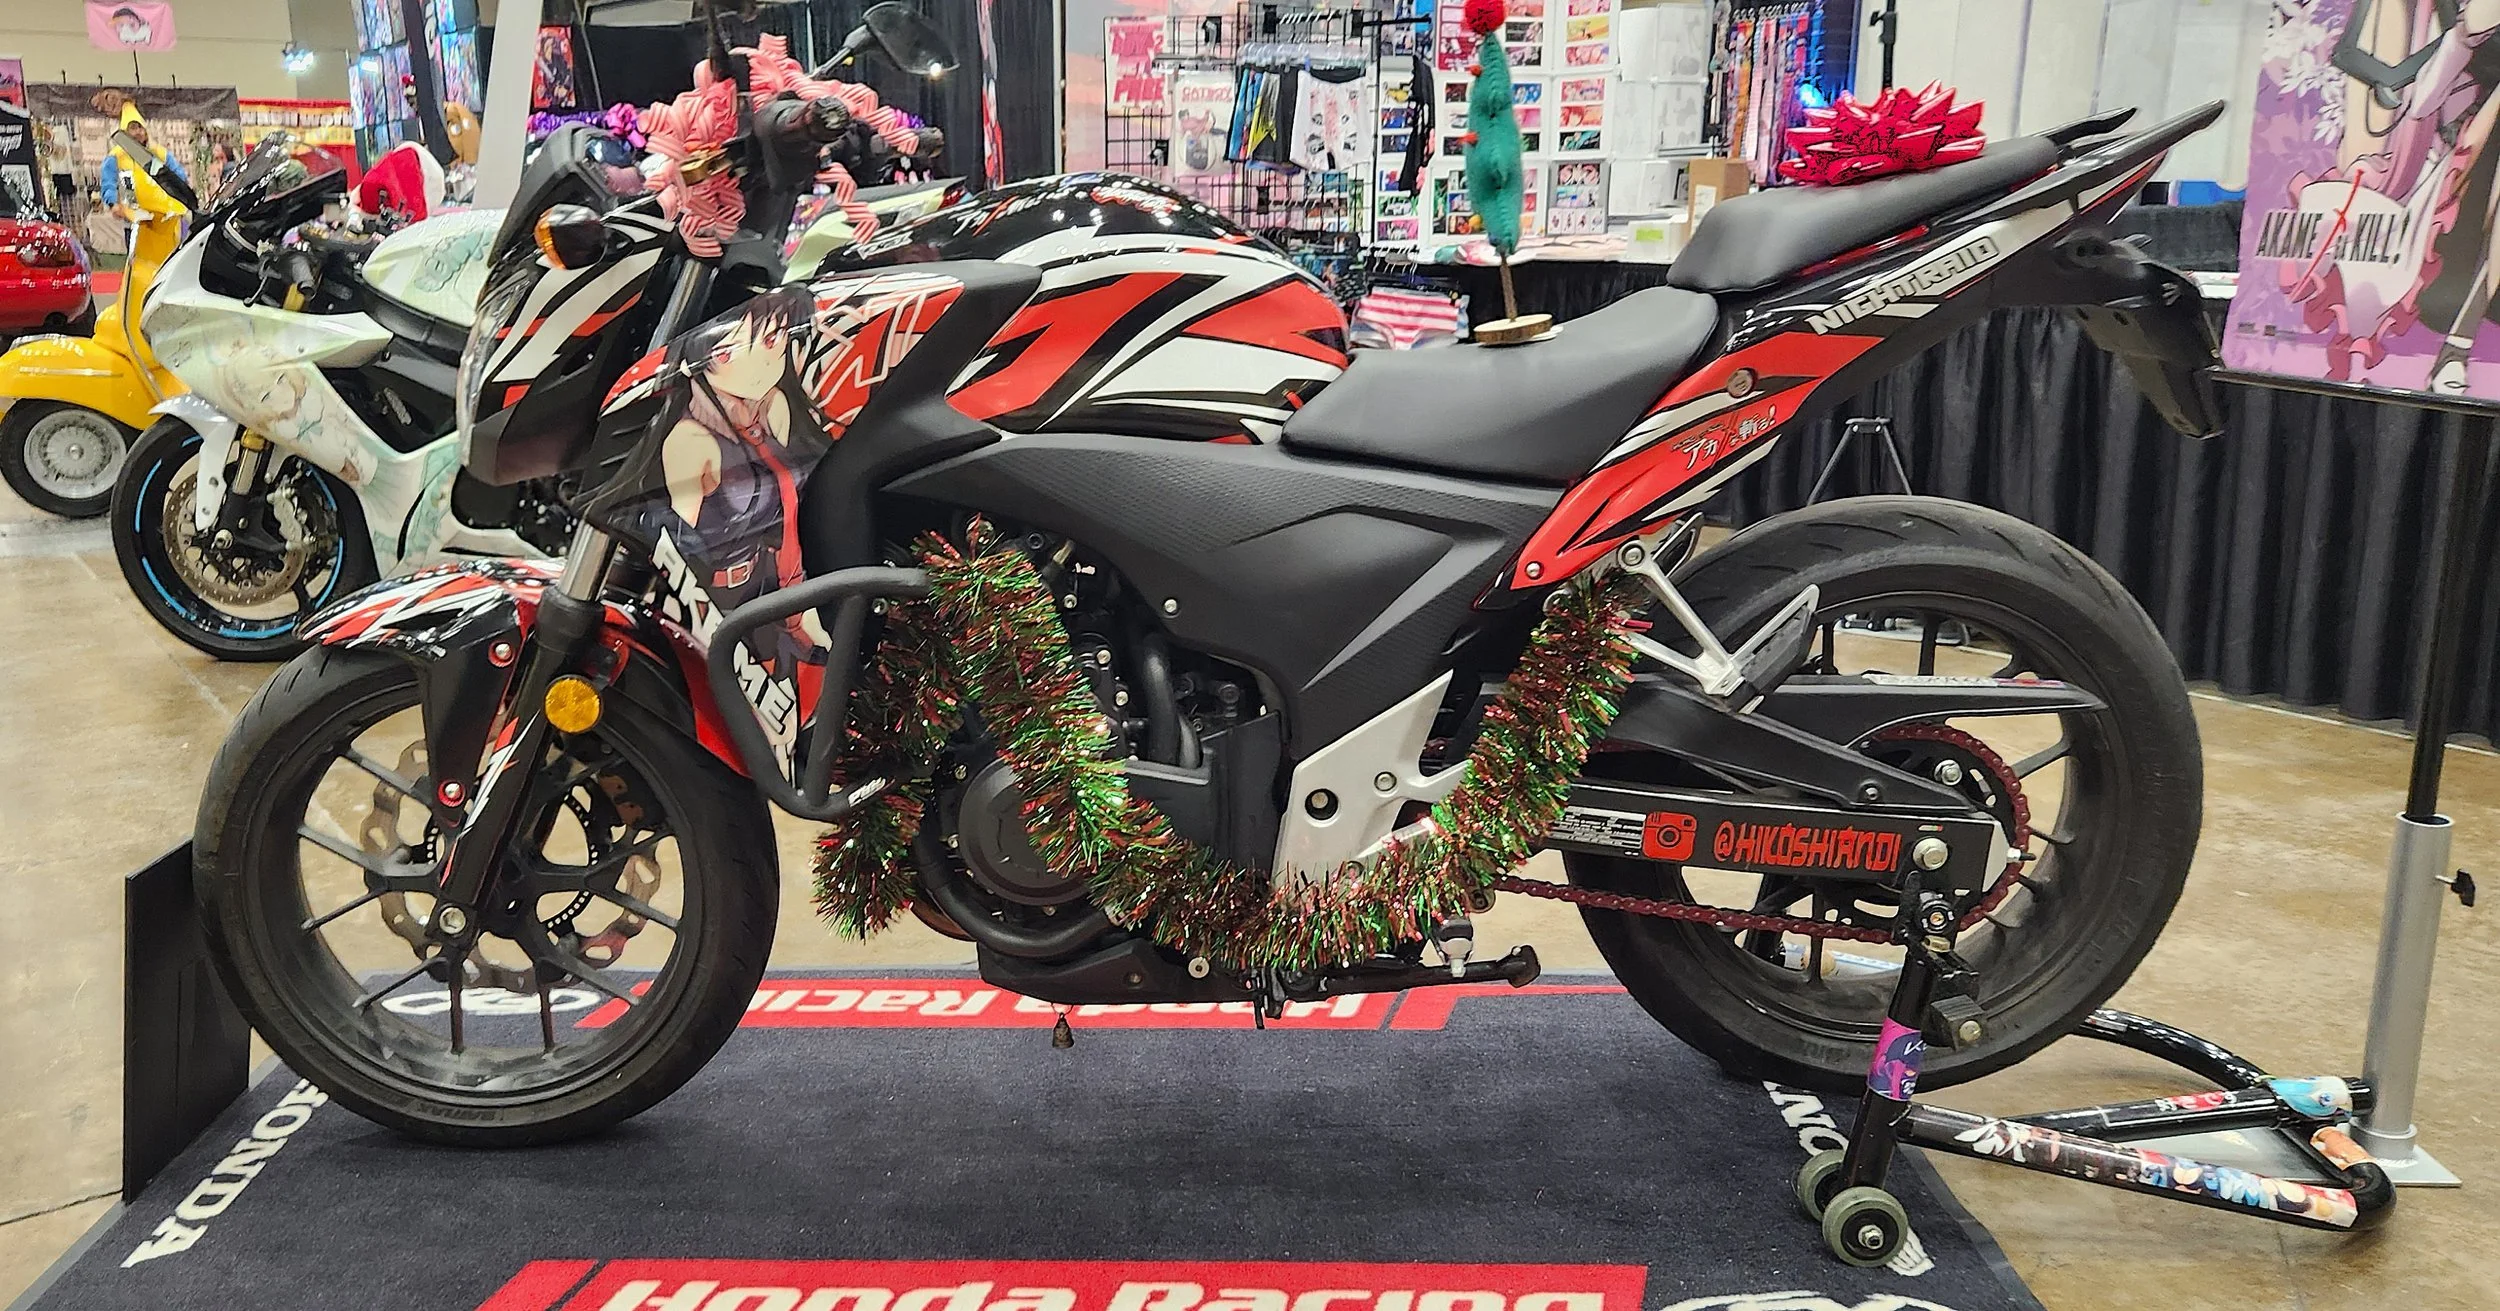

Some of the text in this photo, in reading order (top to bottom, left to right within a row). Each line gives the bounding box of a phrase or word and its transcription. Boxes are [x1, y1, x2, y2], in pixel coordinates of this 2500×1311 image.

[2255, 211, 2324, 259] AKAME
[2349, 209, 2412, 264] KILL!
[1804, 237, 1999, 335] NIGHTRAID
[1713, 820, 1902, 872] @HIKOSHIANDI
[748, 989, 1000, 1017] Raci
